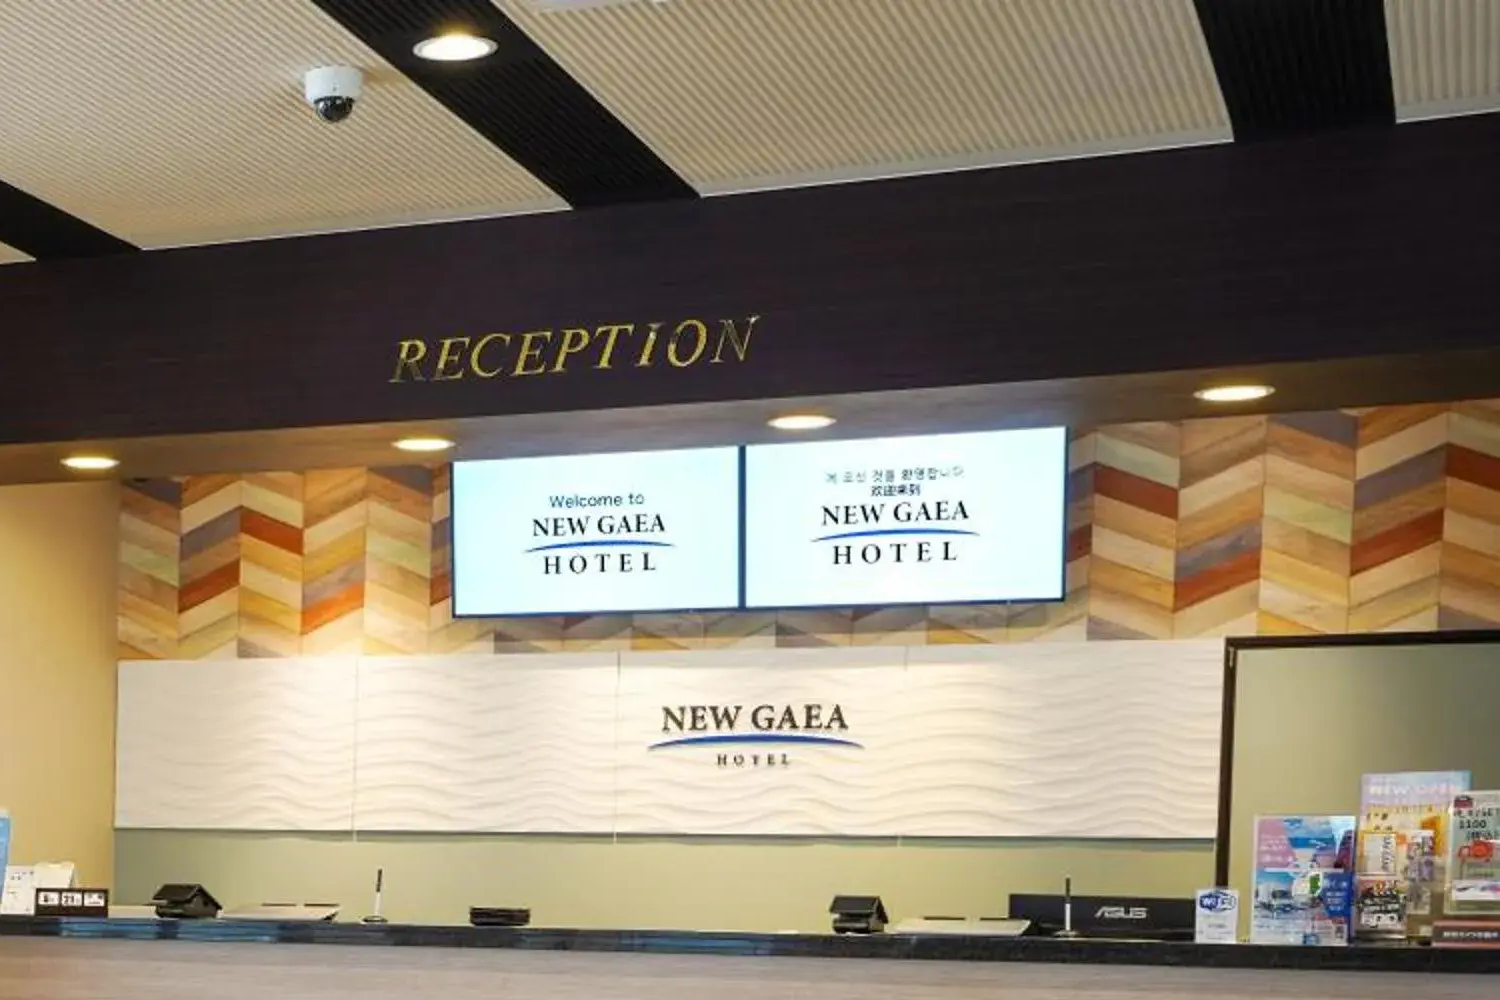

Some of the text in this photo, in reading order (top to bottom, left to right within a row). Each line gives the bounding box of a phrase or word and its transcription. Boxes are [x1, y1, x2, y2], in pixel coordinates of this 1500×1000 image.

[388, 314, 761, 383] RECEPTION
[550, 492, 645, 508] Welcome to
[532, 513, 665, 537] NEW GAEA
[821, 500, 969, 526] NEW GAEA
[543, 551, 656, 575] HOTEL
[833, 541, 957, 564] HOTEL
[662, 704, 849, 731] NEW GAEA
[717, 753, 790, 767] HOTEL
[1095, 906, 1148, 919] ASUS
